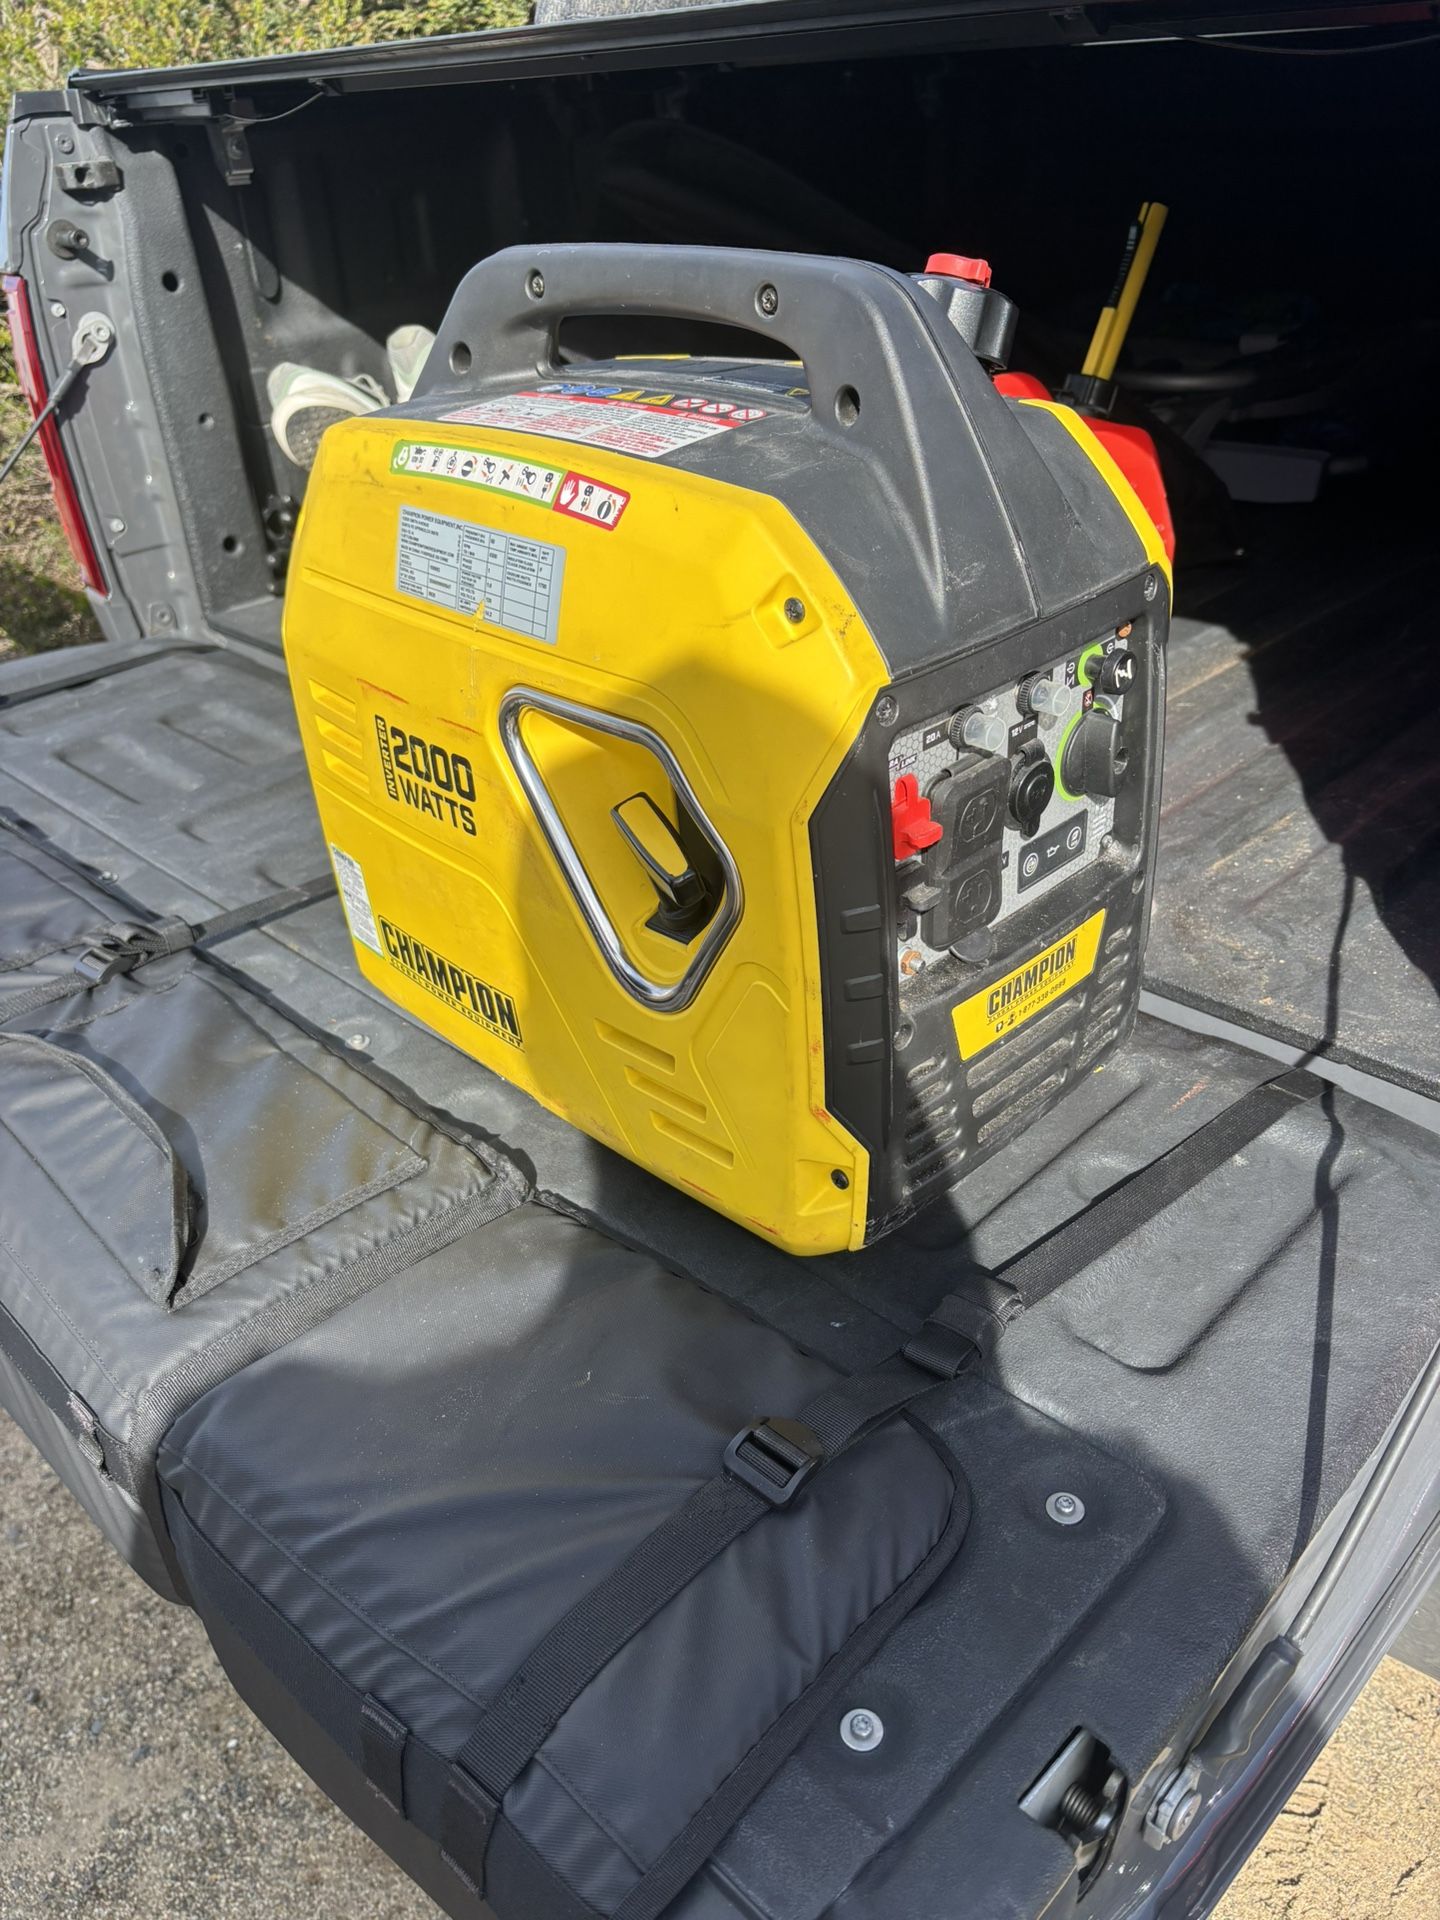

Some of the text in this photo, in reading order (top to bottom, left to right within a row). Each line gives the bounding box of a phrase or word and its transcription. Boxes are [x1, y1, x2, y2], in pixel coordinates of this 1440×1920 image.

[377, 718, 398, 798] INVERTER
[390, 726, 477, 802] 2000
[398, 774, 477, 836] WATTS
[380, 919, 519, 1037] CHAMPION
[390, 958, 522, 1049] GLOBAL POWER EQUIPMENT
[988, 961, 1074, 1023] GLOBAL POWER EQUIPMENT
[989, 937, 1076, 1016] CHAMPION
